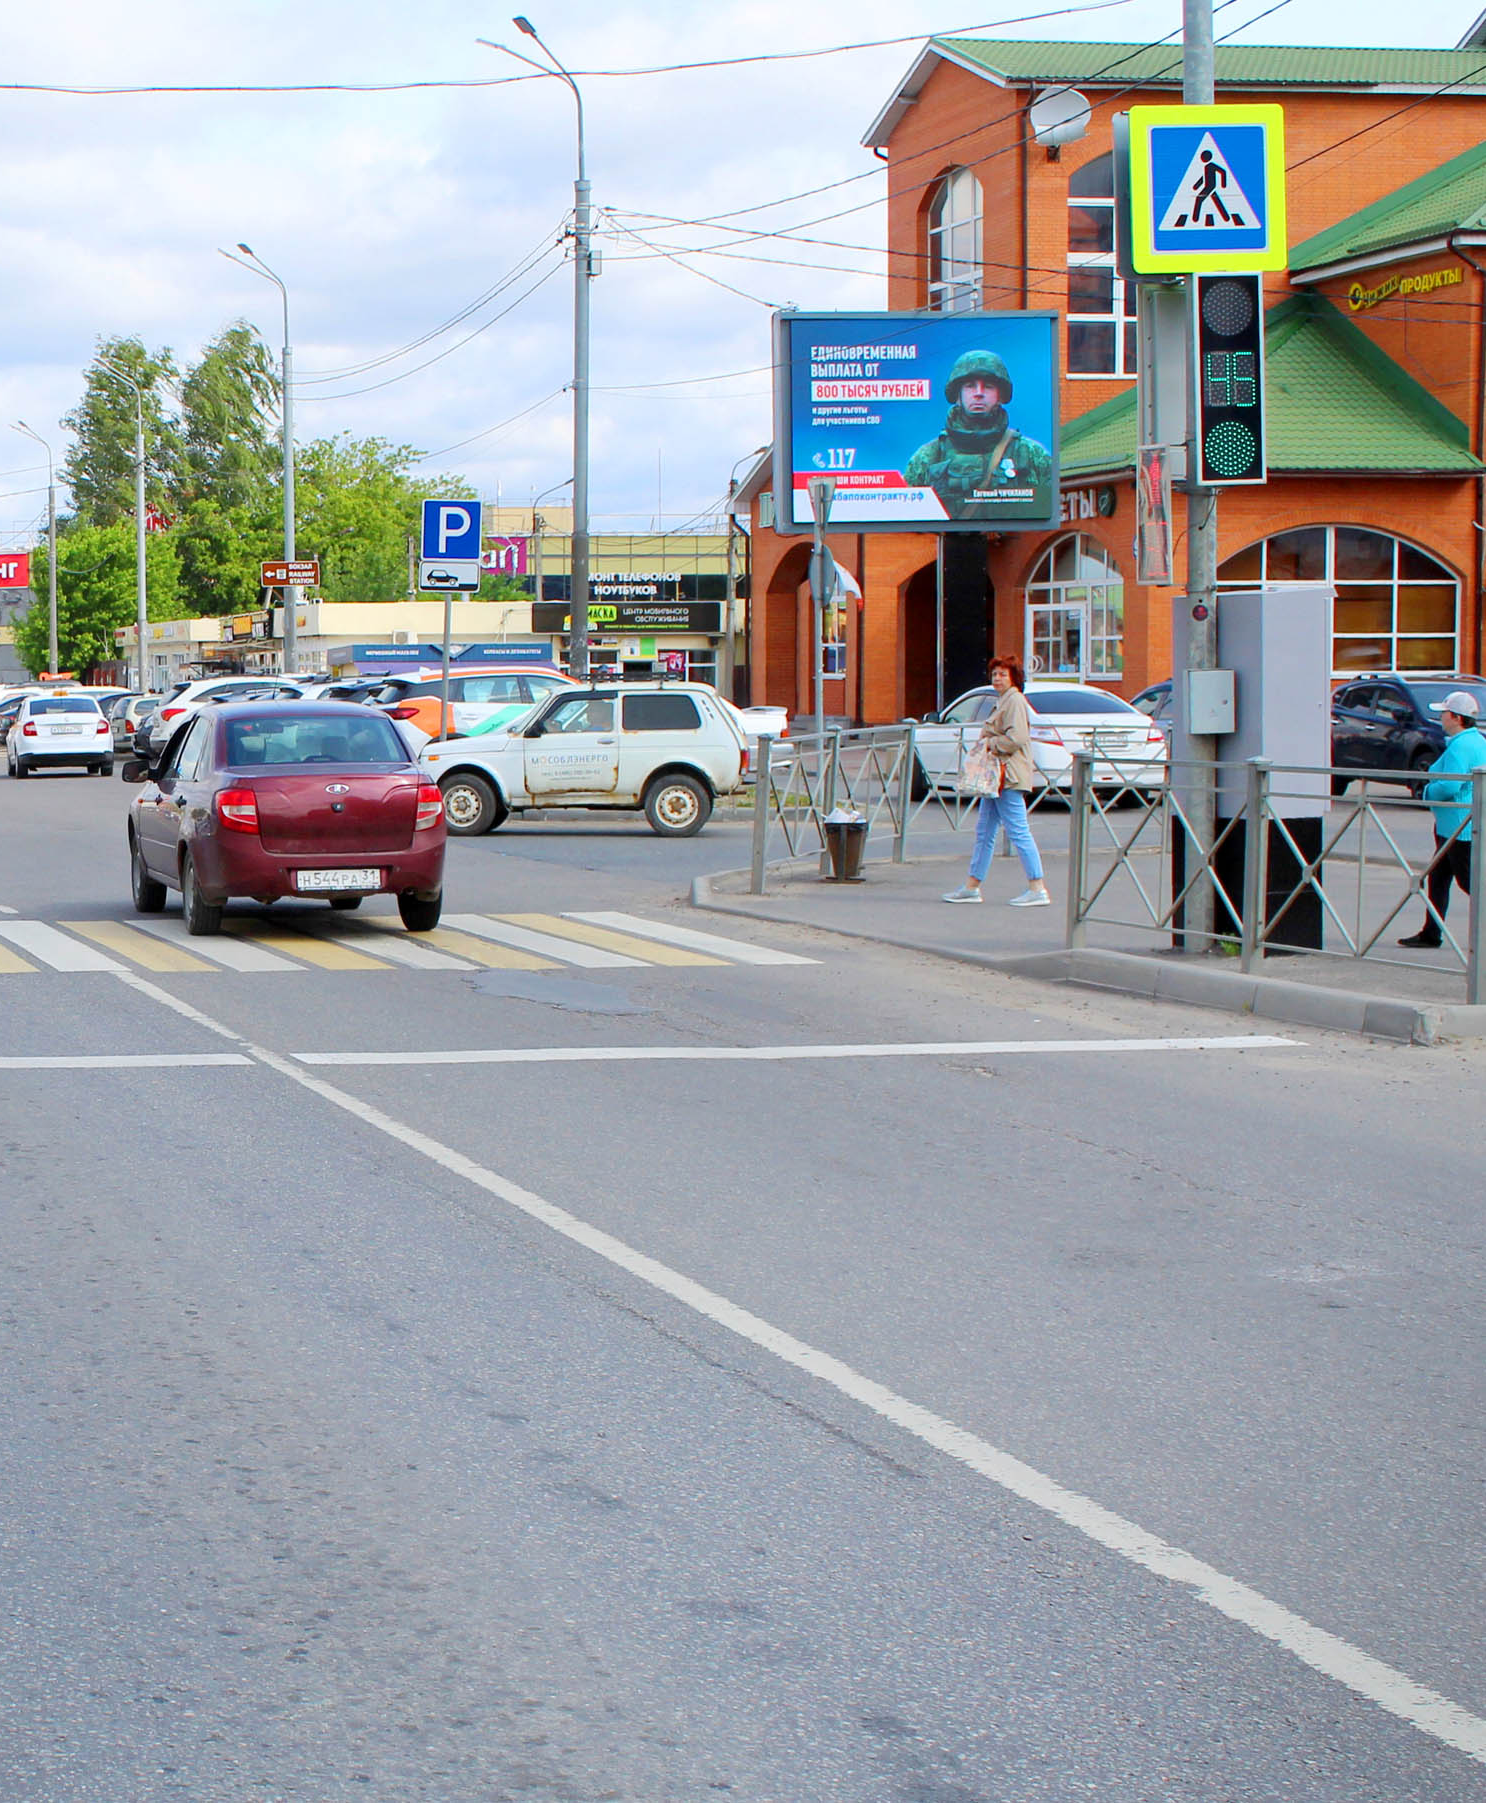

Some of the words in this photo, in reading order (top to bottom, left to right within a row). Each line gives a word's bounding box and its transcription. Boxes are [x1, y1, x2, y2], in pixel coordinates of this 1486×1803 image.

[1400, 267, 1463, 295] ПРОДУКТЫ
[810, 345, 916, 361] ЕДИНОВРЕМЕННАЯ
[811, 363, 863, 377] ВЫПЛАТА
[865, 362, 879, 377] ОТ
[1207, 351, 1256, 407] 45
[816, 386, 839, 398] 800
[841, 383, 879, 397] ТЫСЯЧ
[882, 380, 925, 397] РУБЛЕЙ
[827, 448, 855, 468] 117
[850, 475, 885, 485] КОНТРАКТ
[618, 572, 682, 582] ТЕЛЕФОНОВ
[594, 585, 657, 595] НОУТБУКОВ
[531, 754, 609, 764] МОСОБЛЭНЕРГО
